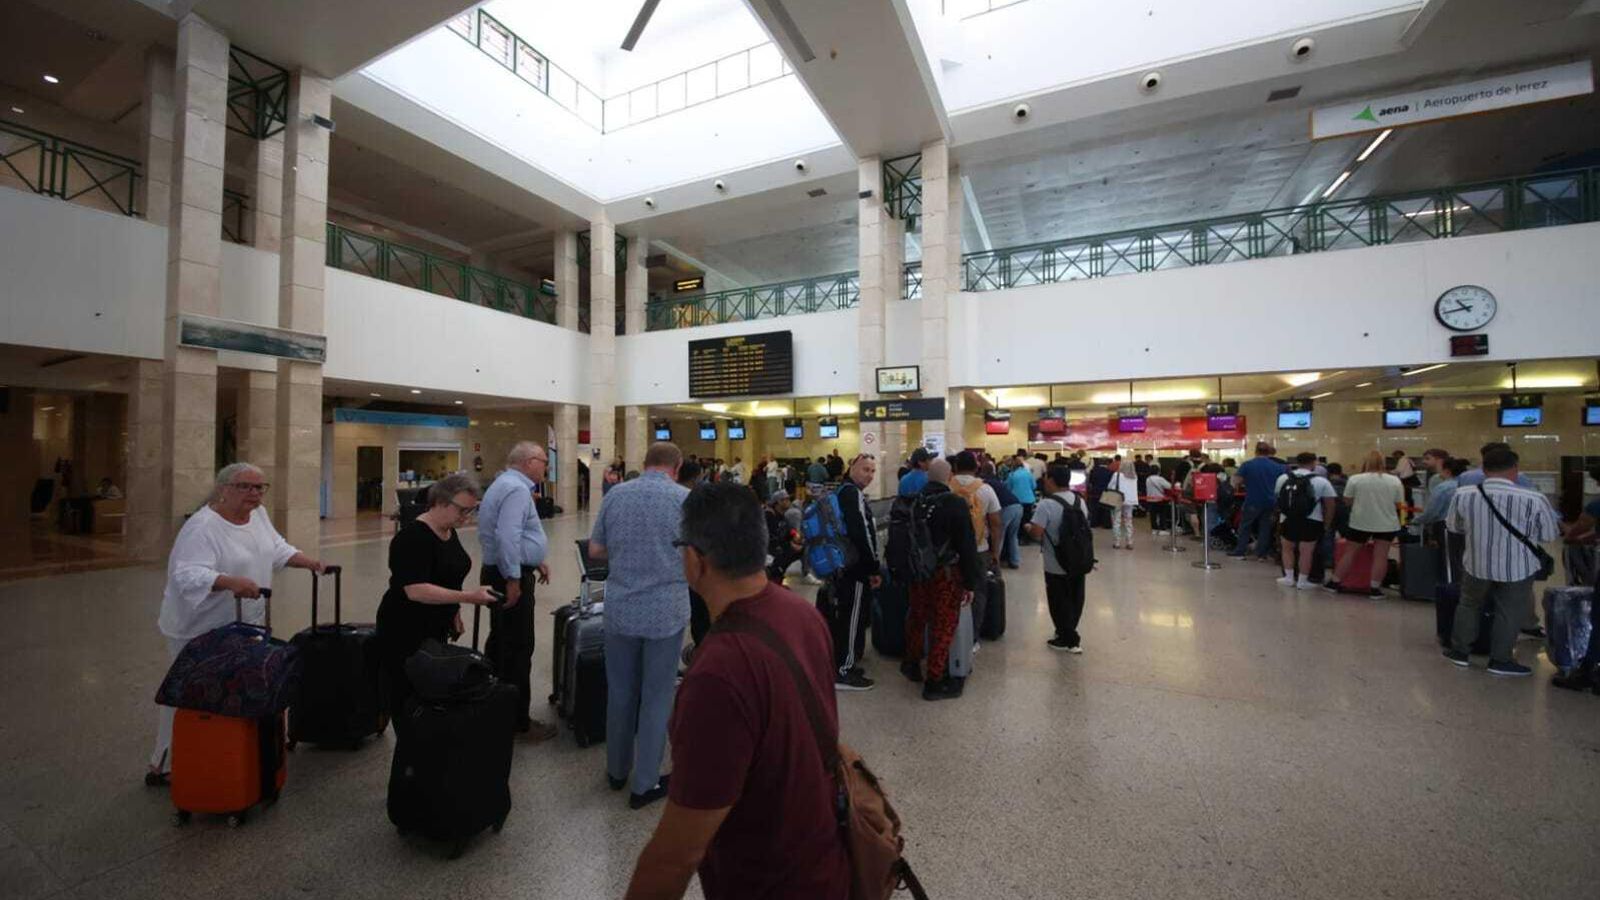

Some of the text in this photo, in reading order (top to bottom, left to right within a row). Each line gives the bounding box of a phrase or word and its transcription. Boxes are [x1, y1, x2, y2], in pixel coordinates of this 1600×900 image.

[1379, 80, 1549, 116] aena Aeropuerto de Jerez
